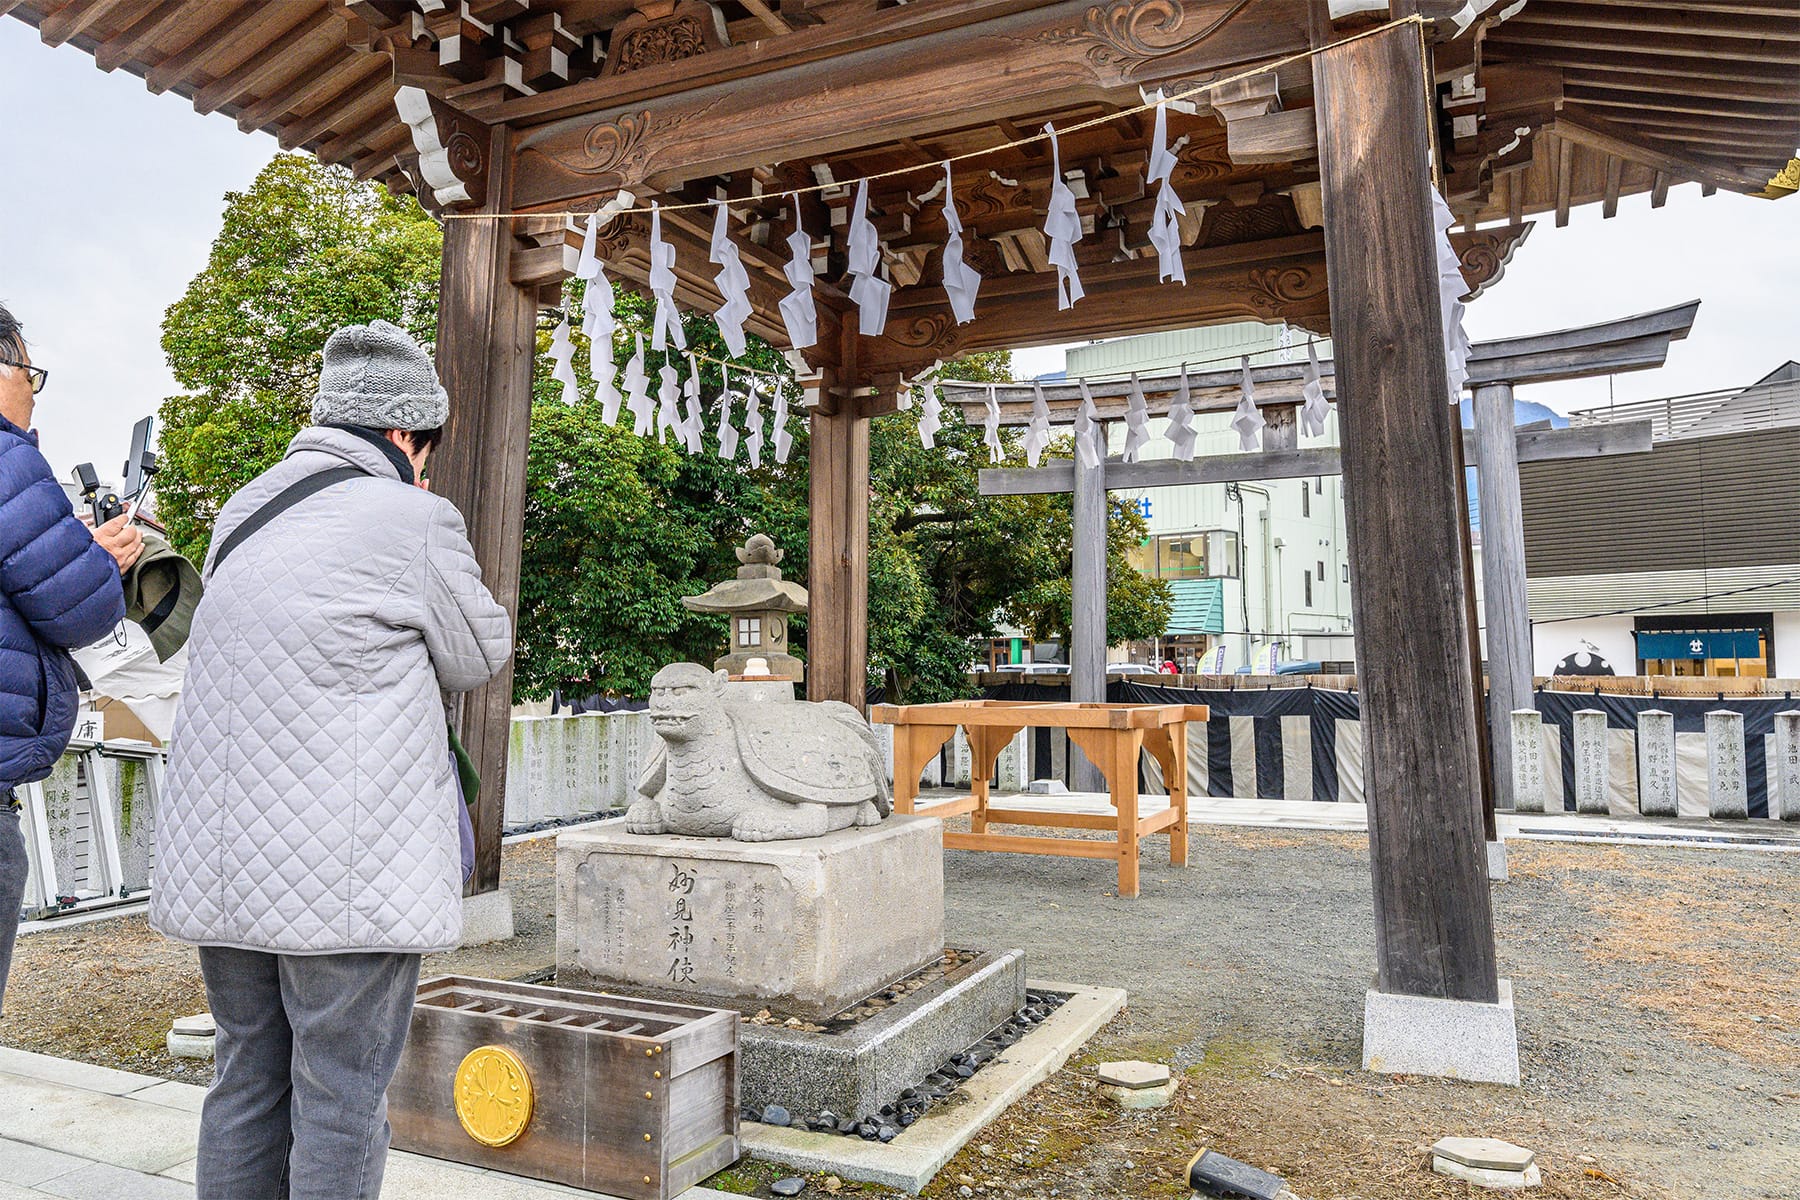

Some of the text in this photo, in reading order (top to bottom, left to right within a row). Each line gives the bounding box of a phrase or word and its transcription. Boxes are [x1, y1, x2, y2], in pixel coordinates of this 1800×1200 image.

[667, 863, 698, 984] 妙見神使
[752, 882, 765, 933] 秩父神社
